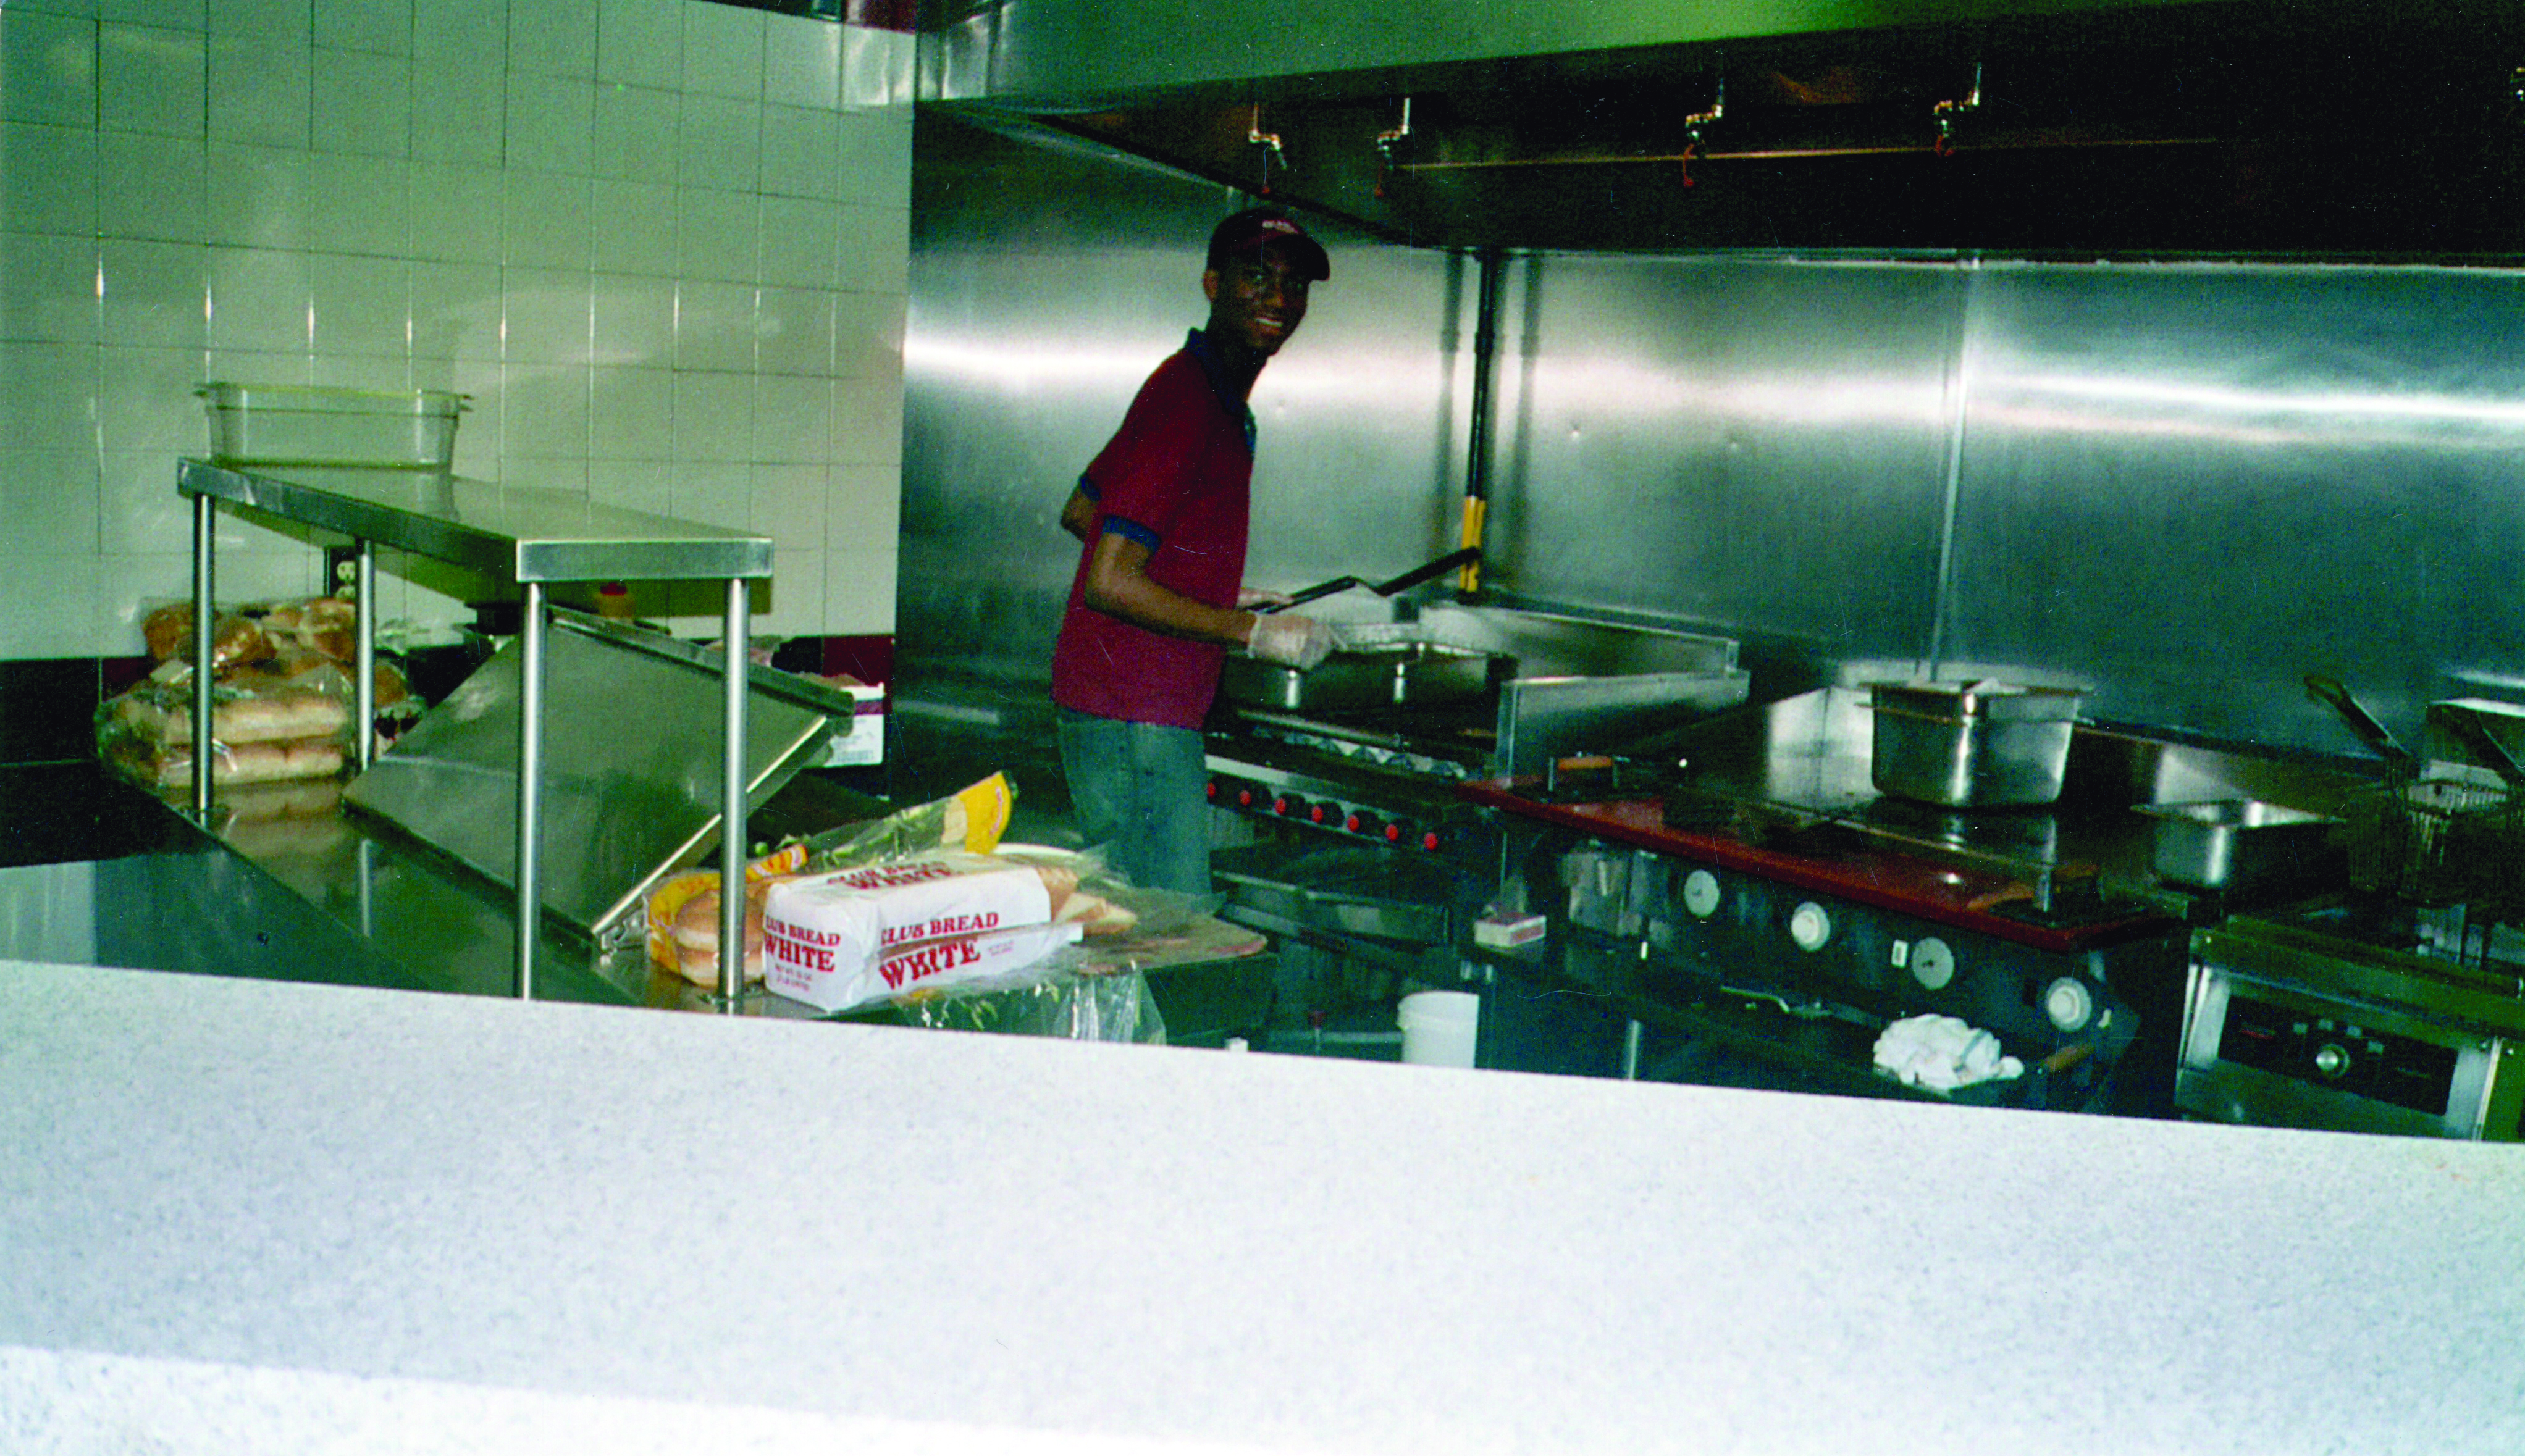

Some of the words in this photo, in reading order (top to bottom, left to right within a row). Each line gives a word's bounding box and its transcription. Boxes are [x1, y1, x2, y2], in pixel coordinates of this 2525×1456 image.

[788, 923, 841, 947] BREAD
[930, 913, 999, 935] BREAD
[763, 929, 835, 973] WHITE
[879, 939, 981, 990] WHITE
